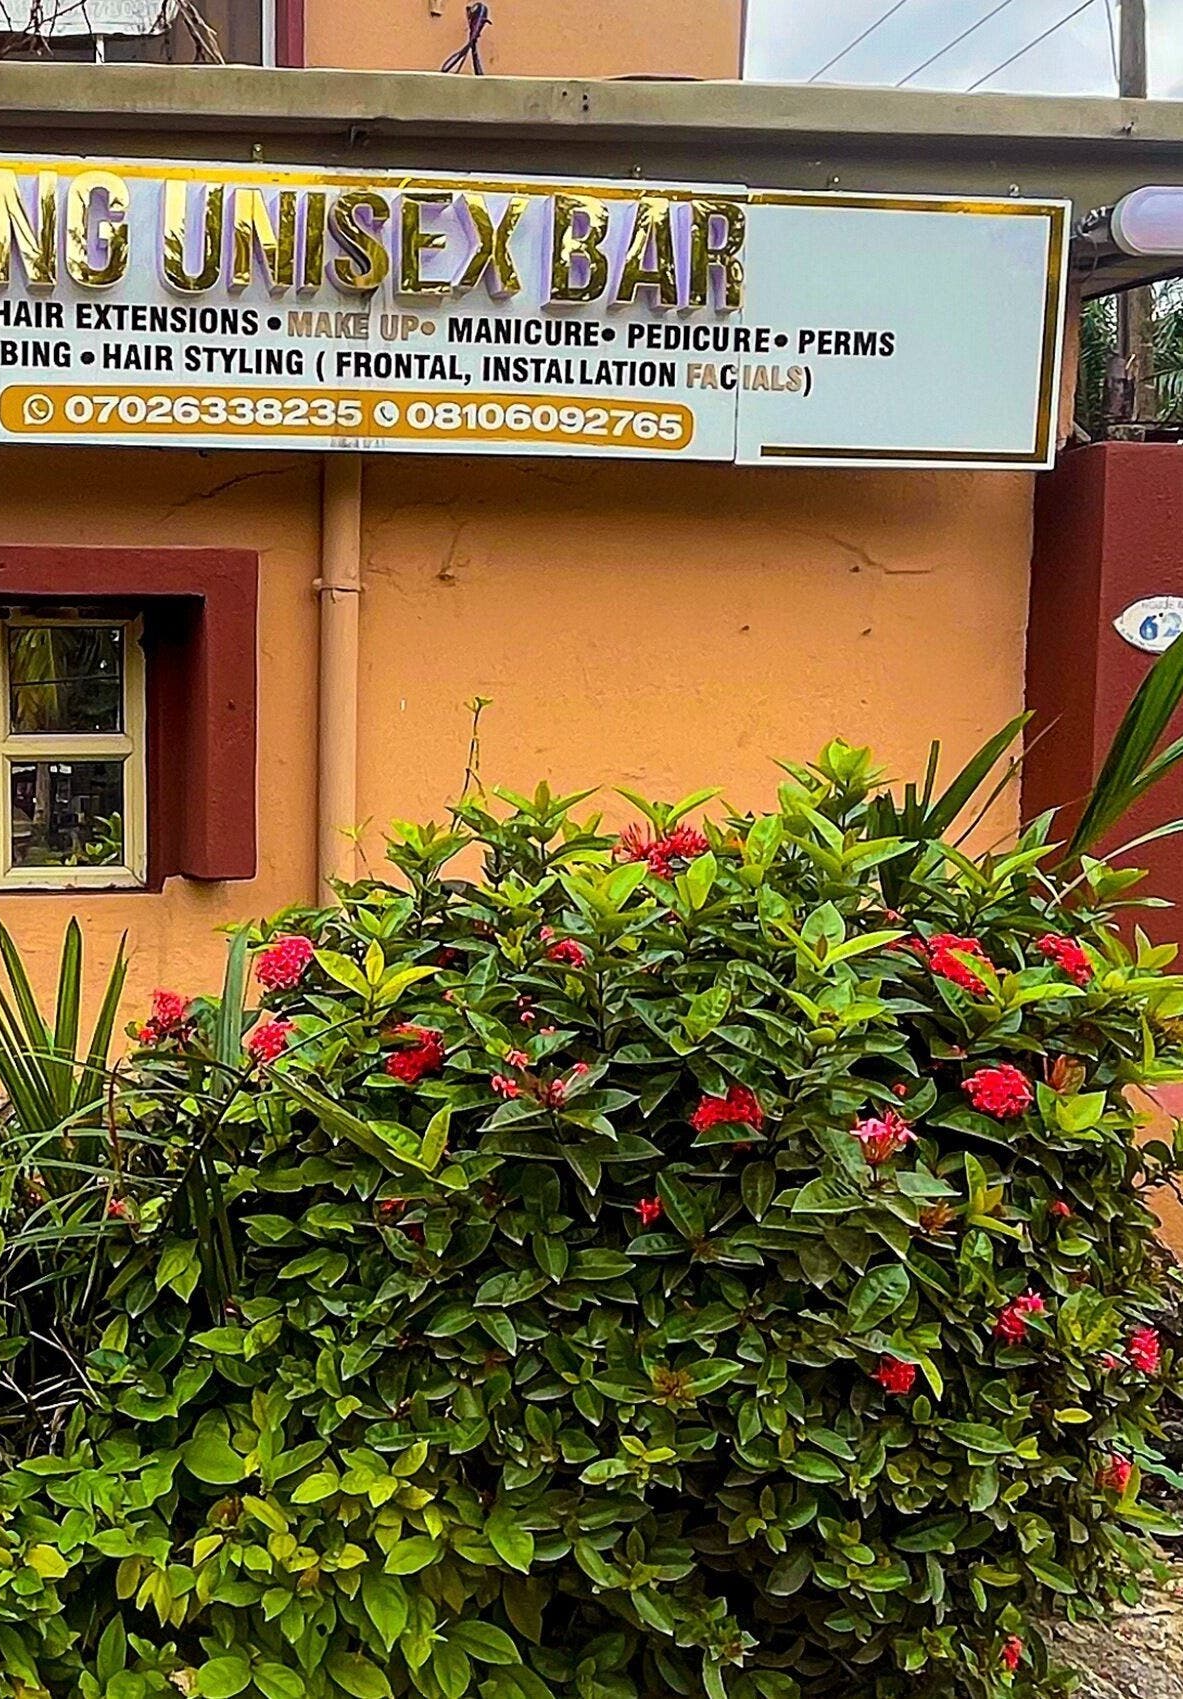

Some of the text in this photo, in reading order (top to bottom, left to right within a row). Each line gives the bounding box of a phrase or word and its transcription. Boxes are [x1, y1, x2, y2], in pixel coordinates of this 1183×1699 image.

[157, 176, 527, 303] UNISEX
[542, 194, 748, 316] BAR
[76, 303, 259, 336] EXTENSIONS
[287, 311, 369, 339] MAKE
[380, 315, 418, 341] UP
[448, 316, 600, 347] MANICURE
[628, 324, 772, 353] PEDICURE
[798, 330, 896, 357] PERMS
[102, 343, 174, 372] HAIR
[184, 347, 305, 376] STYLING
[336, 353, 472, 385] FRONTAL,
[482, 357, 677, 388] INSTALLATION
[64, 396, 684, 442] 07026338235 08106092765
